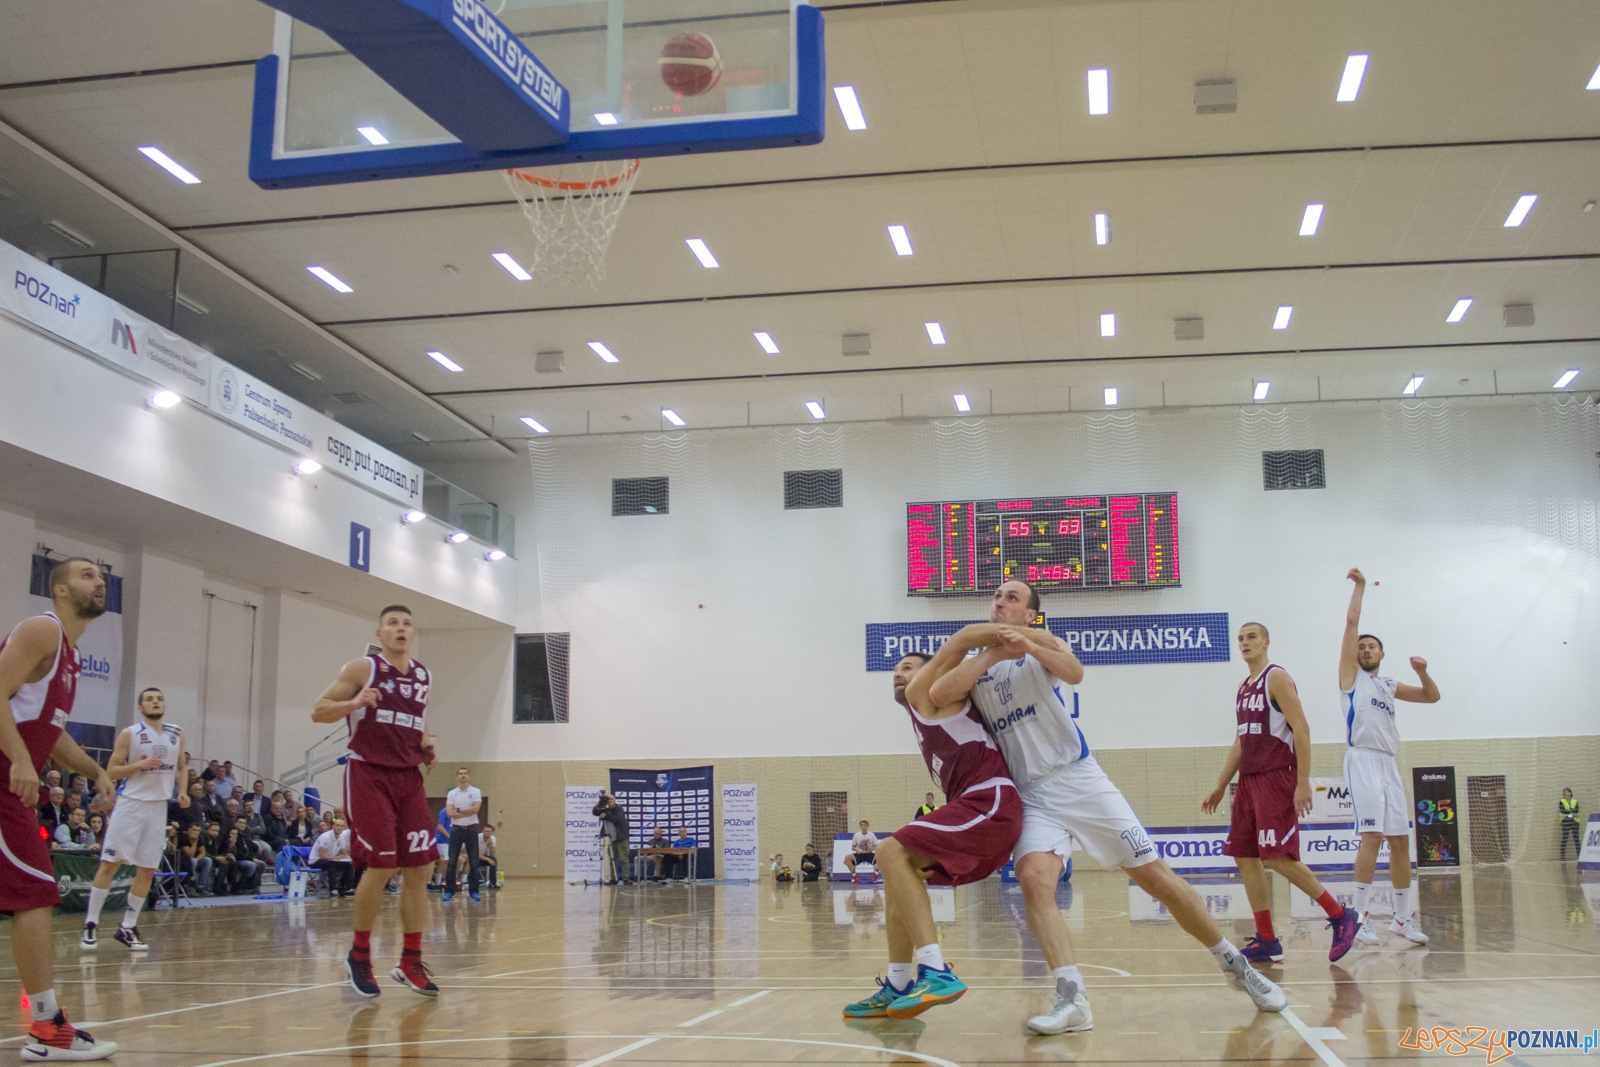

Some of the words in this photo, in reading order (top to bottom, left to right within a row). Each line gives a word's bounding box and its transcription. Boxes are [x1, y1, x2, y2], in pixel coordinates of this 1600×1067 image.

[245, 384, 272, 408] Centrum
[272, 398, 293, 419] Sportu
[327, 436, 419, 498] cspp.put.poznan.pl
[1009, 521, 1031, 537] 55
[1058, 519, 1081, 535] 63
[357, 530, 365, 566] 1
[1065, 624, 1212, 652] POZNAŃSKA
[1248, 694, 1265, 711] 44
[1327, 786, 1350, 799] MA
[406, 829, 430, 853] 22
[1121, 826, 1150, 851] 12
[1258, 829, 1277, 847] 44
